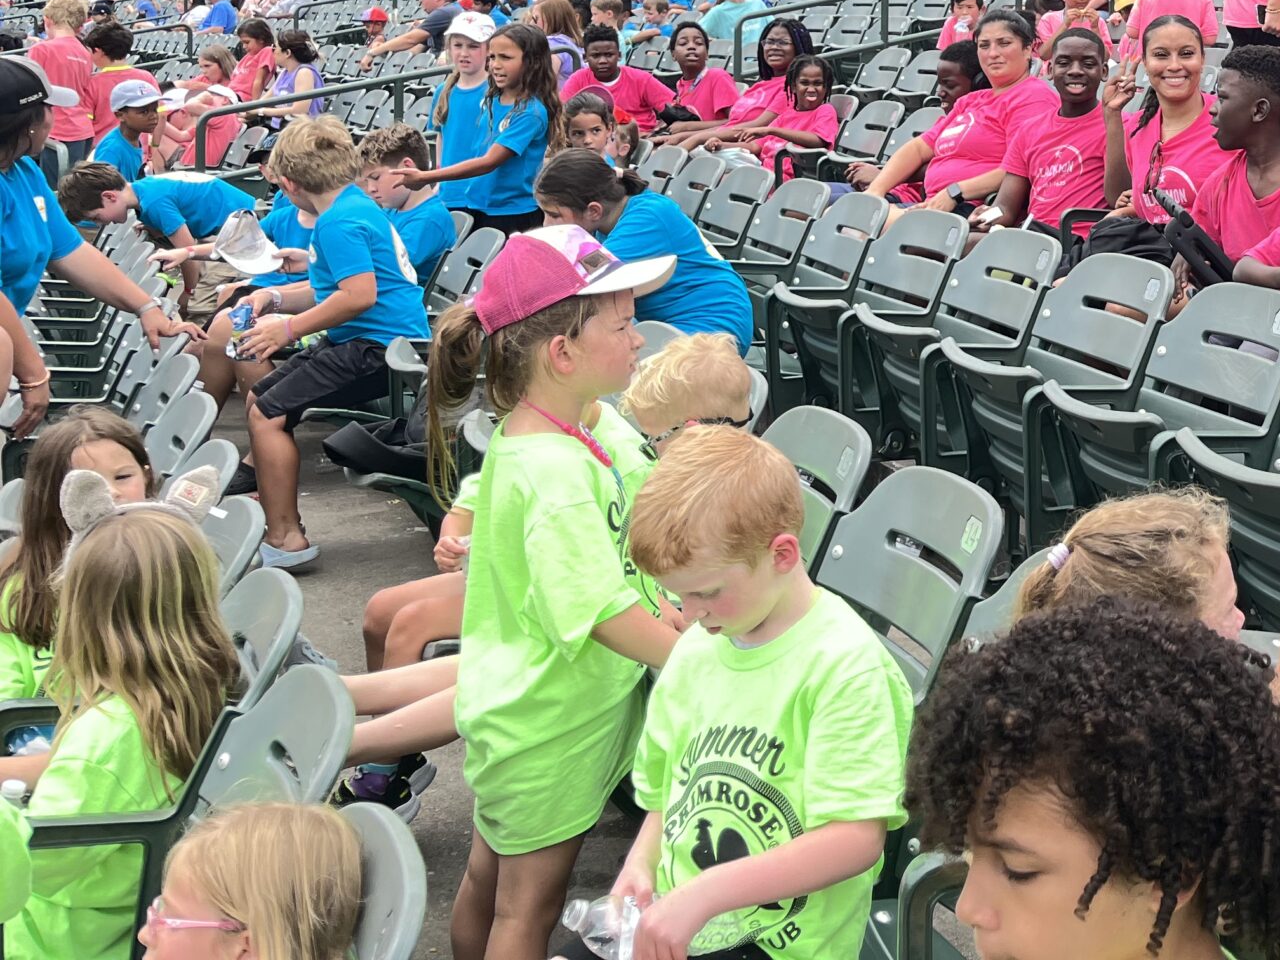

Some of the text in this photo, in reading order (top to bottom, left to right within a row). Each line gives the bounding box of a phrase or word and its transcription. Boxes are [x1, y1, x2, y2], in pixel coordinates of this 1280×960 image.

[679, 723, 786, 787] Summer
[664, 780, 784, 844] PRIMROSE
[766, 920, 802, 951] UB
